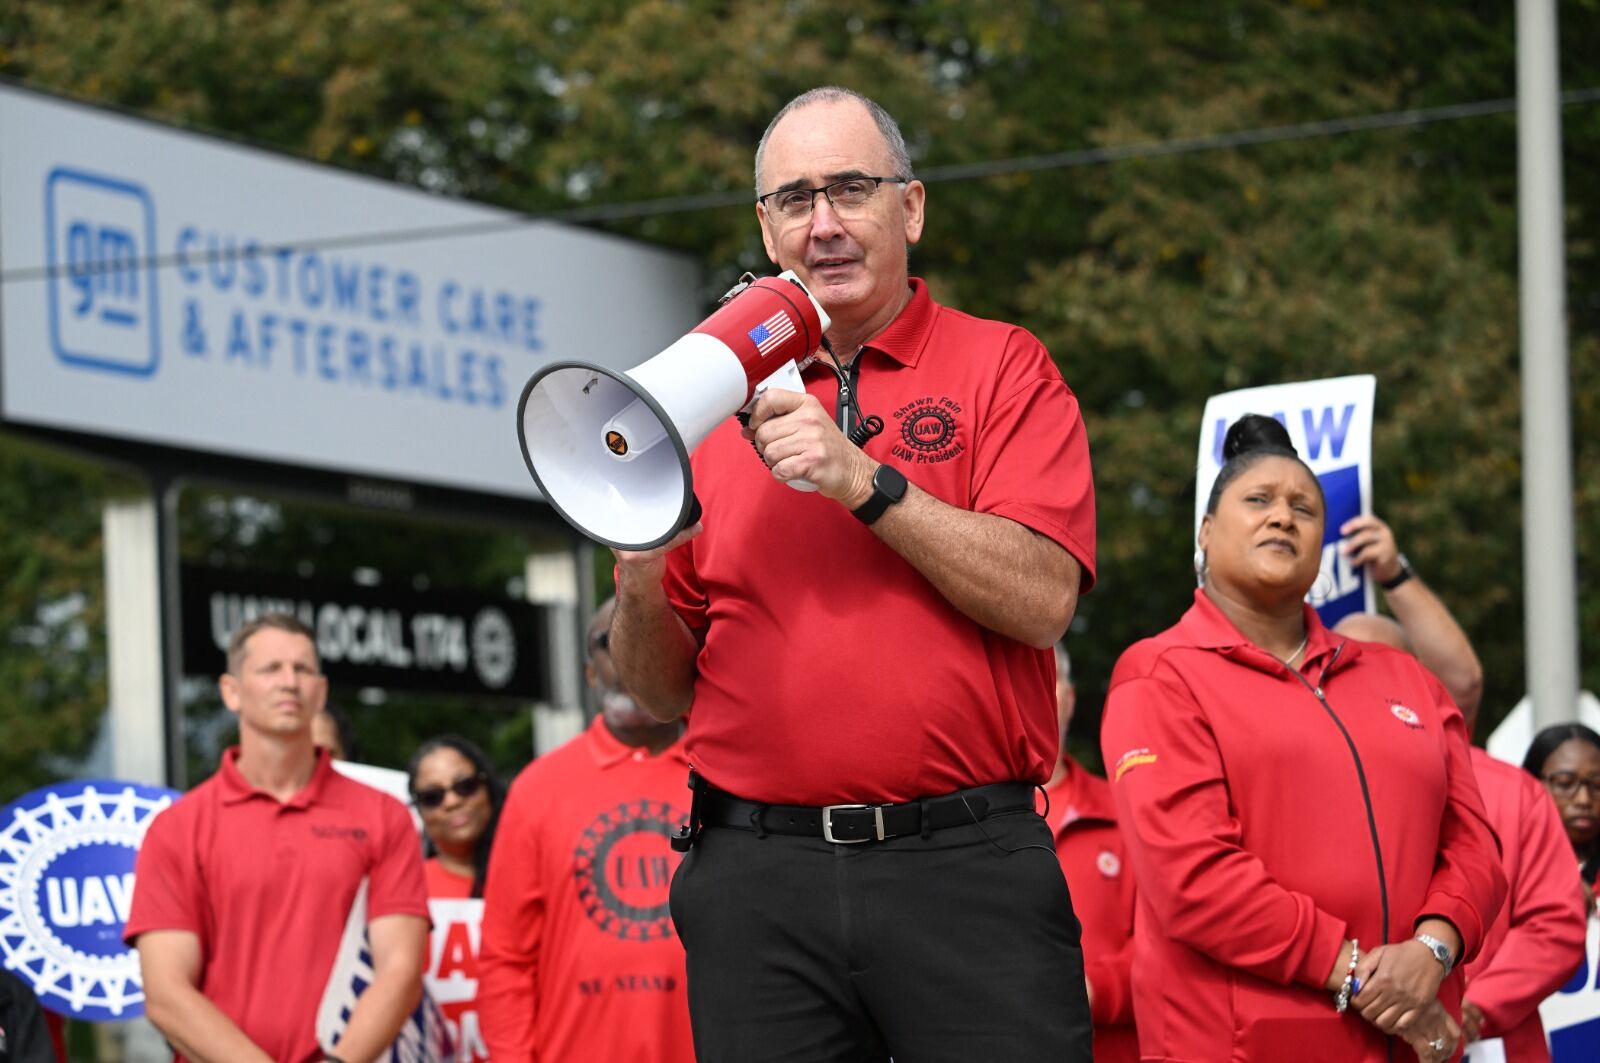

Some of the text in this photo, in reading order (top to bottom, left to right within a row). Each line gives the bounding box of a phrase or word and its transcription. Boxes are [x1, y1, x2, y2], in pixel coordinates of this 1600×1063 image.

[67, 220, 138, 317] gm
[177, 227, 544, 350] CUSTOMER CARE
[182, 299, 506, 408] & AFTERSALES
[893, 396, 962, 419] Shawn Fain
[914, 422, 941, 435] UAW
[892, 442, 965, 464] UAW President
[411, 613, 467, 671] 174
